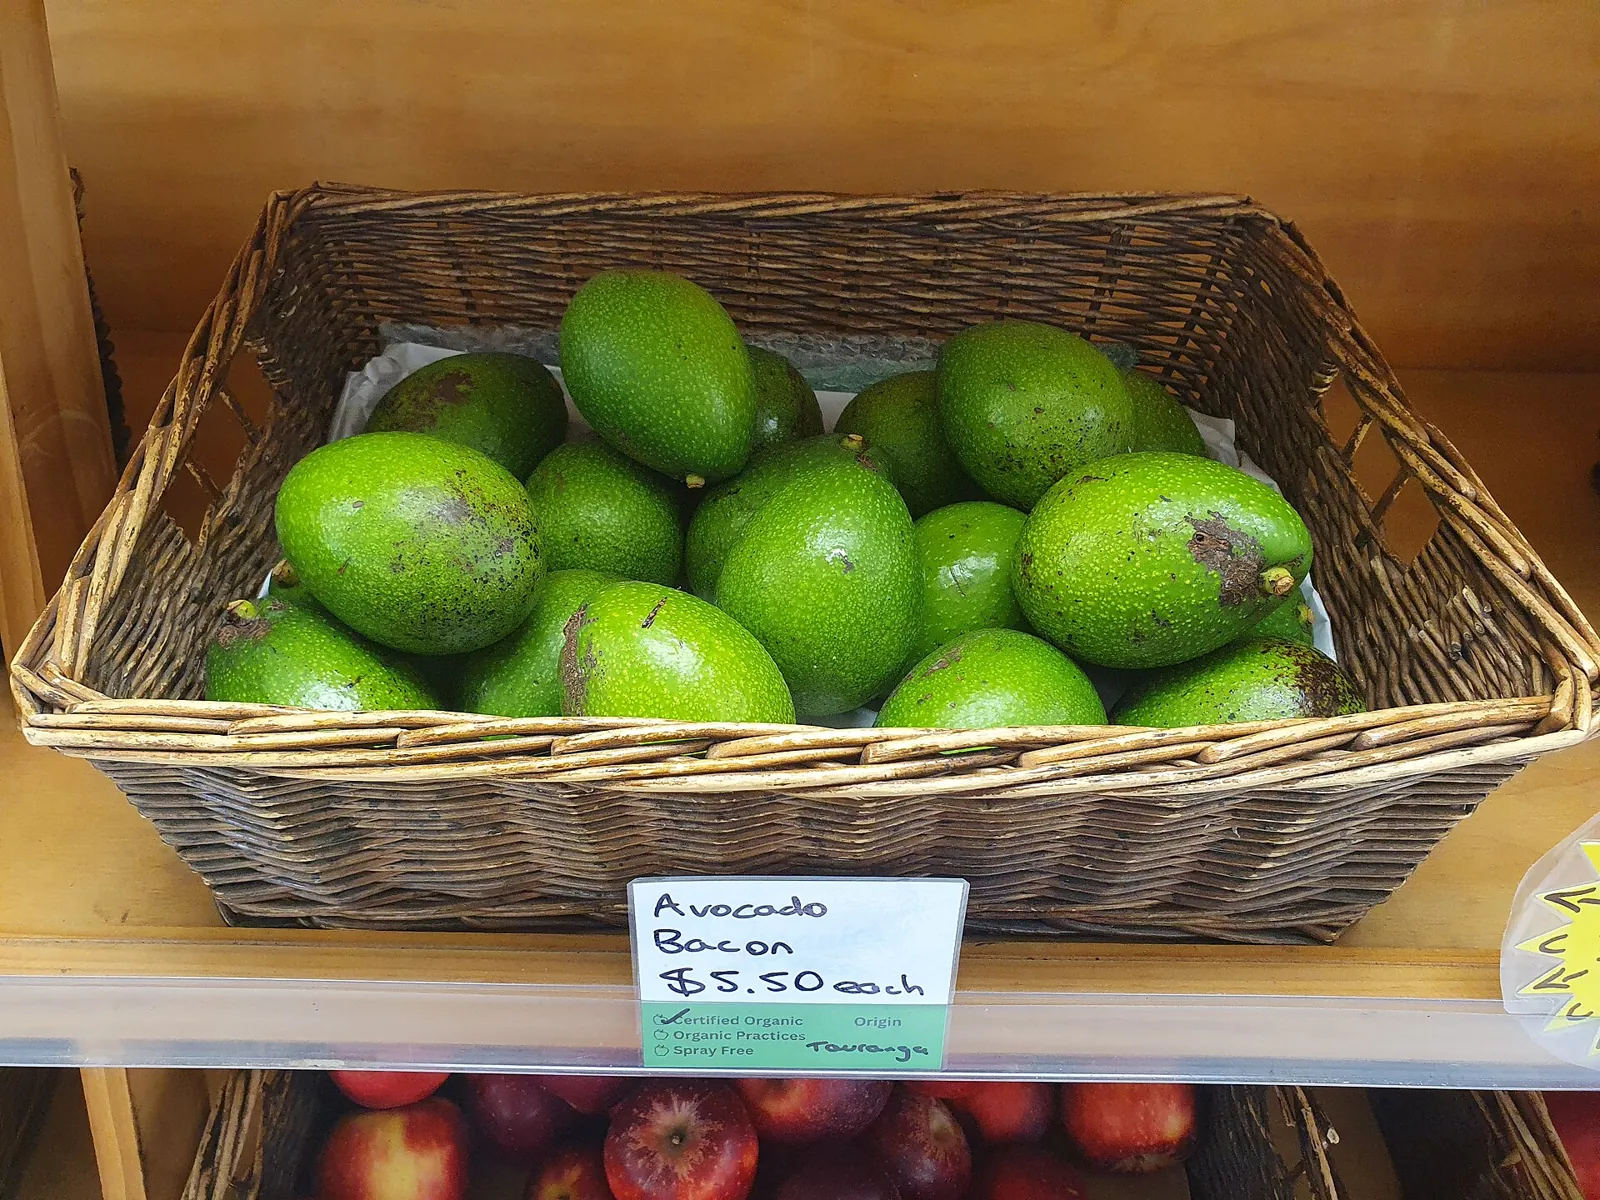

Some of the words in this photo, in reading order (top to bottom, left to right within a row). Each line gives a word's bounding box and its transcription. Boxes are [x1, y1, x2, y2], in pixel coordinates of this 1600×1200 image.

[653, 893, 828, 918] Avocado
[653, 929, 793, 956] Bacon
[659, 967, 824, 997] $5.50
[833, 974, 925, 996] each
[744, 1015, 803, 1028] Organic
[854, 1016, 902, 1028] Origin
[673, 1030, 732, 1042] Organic
[736, 1030, 806, 1041] Practices
[673, 1045, 718, 1058] Spray
[721, 1045, 754, 1055] Free
